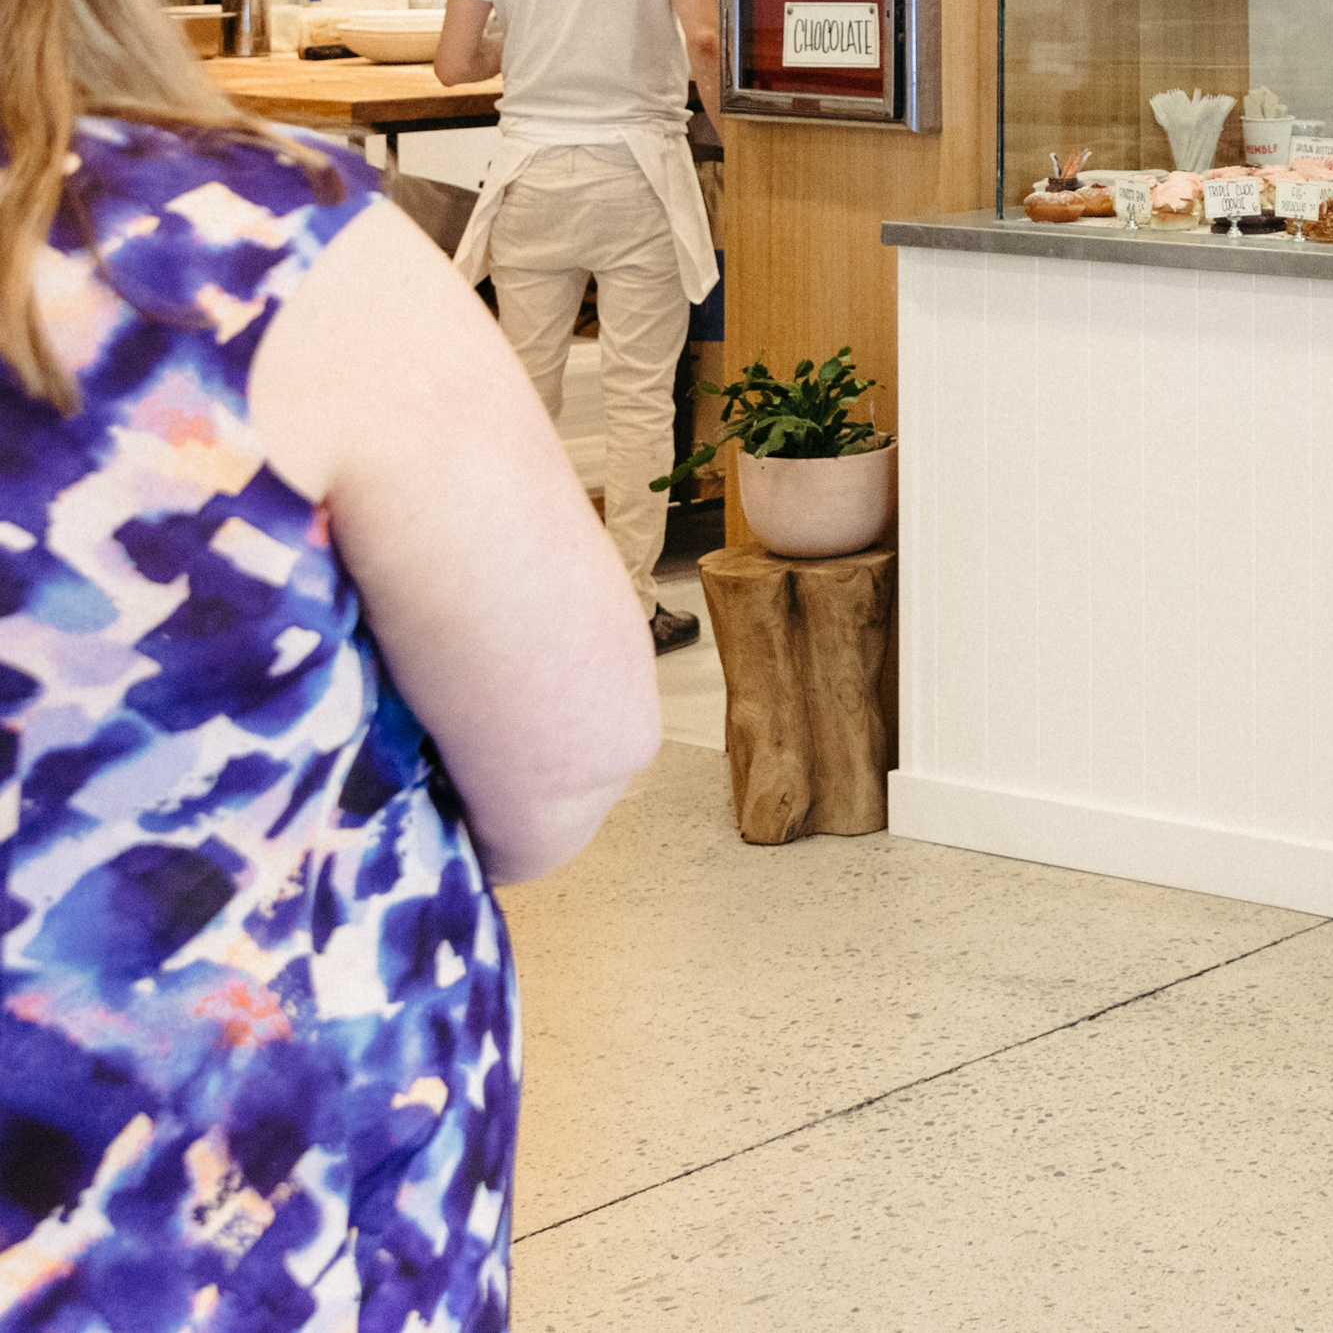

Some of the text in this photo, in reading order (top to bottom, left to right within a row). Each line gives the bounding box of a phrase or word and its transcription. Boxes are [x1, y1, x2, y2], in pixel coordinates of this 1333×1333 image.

[793, 18, 873, 55] CHOCOLATE
[1207, 183, 1254, 198] TRIPLE CHOC
